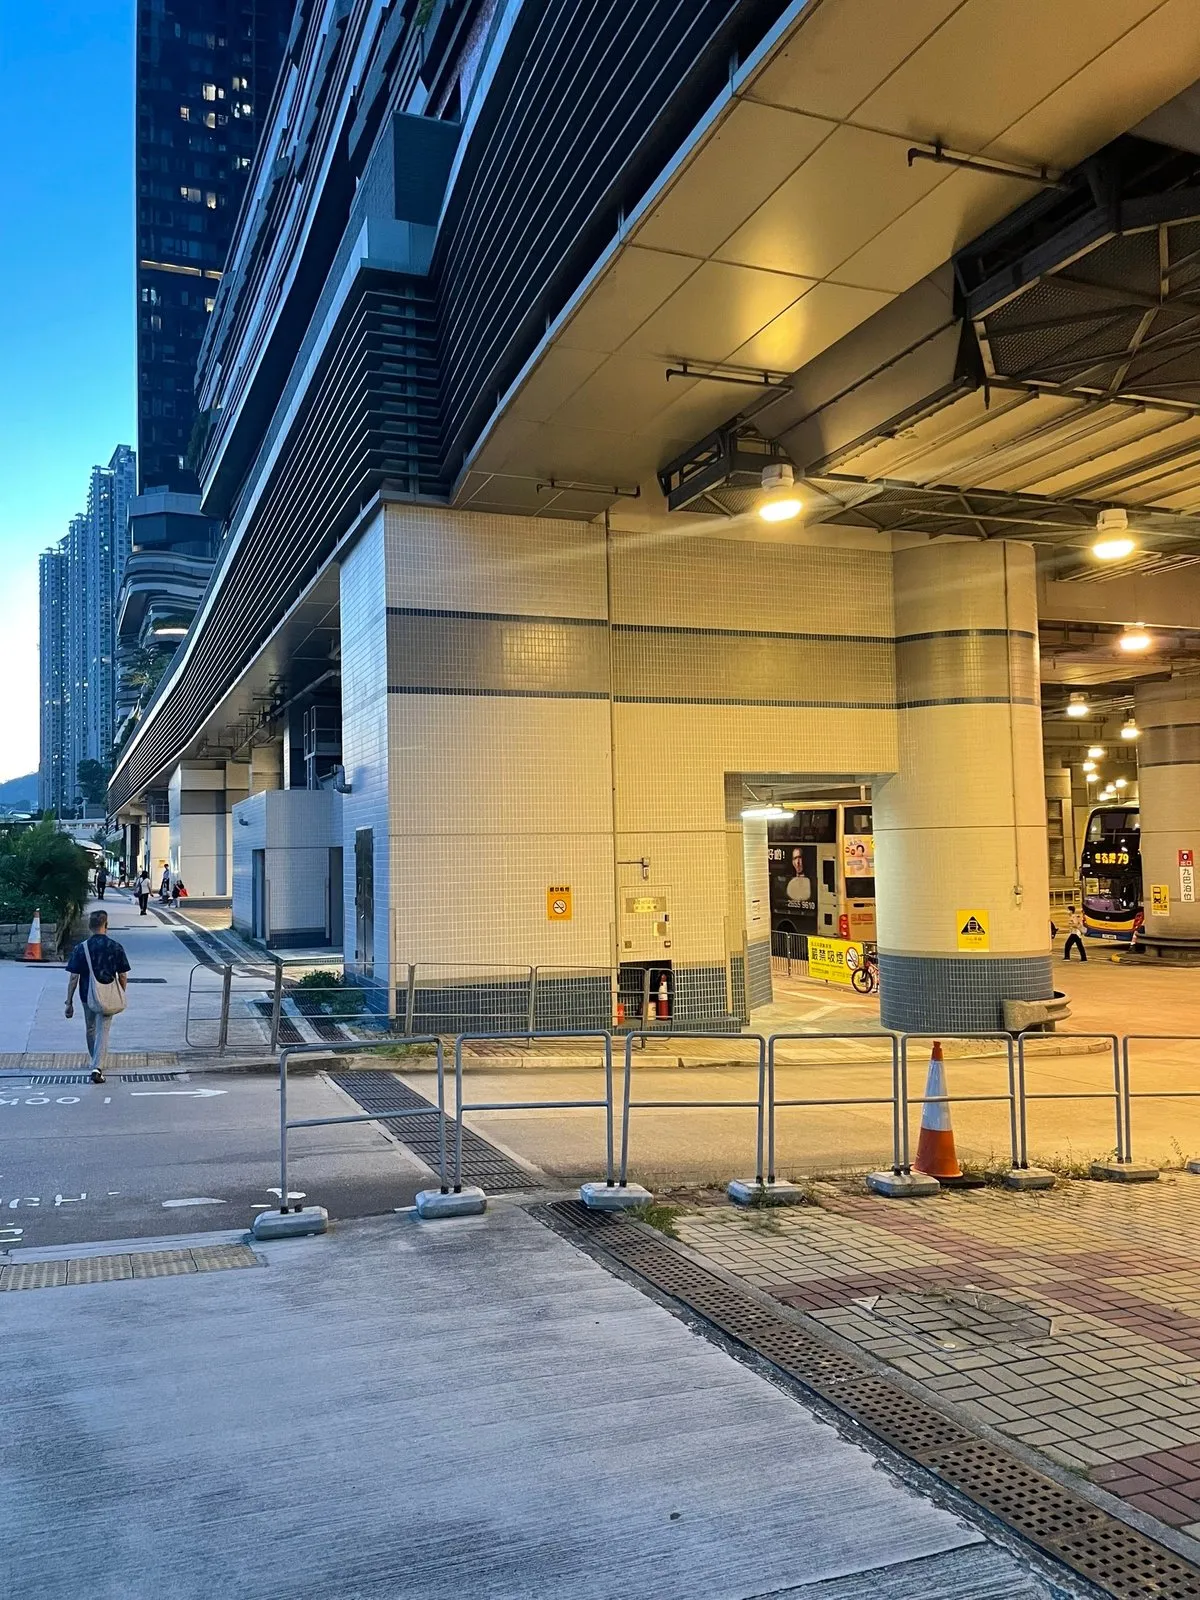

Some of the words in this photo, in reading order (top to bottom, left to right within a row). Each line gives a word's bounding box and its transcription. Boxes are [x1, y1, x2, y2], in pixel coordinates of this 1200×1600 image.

[1118, 853, 1129, 864] 79
[1182, 868, 1193, 901] 九巴泊位
[812, 948, 843, 964] 嚴禁吸煙
